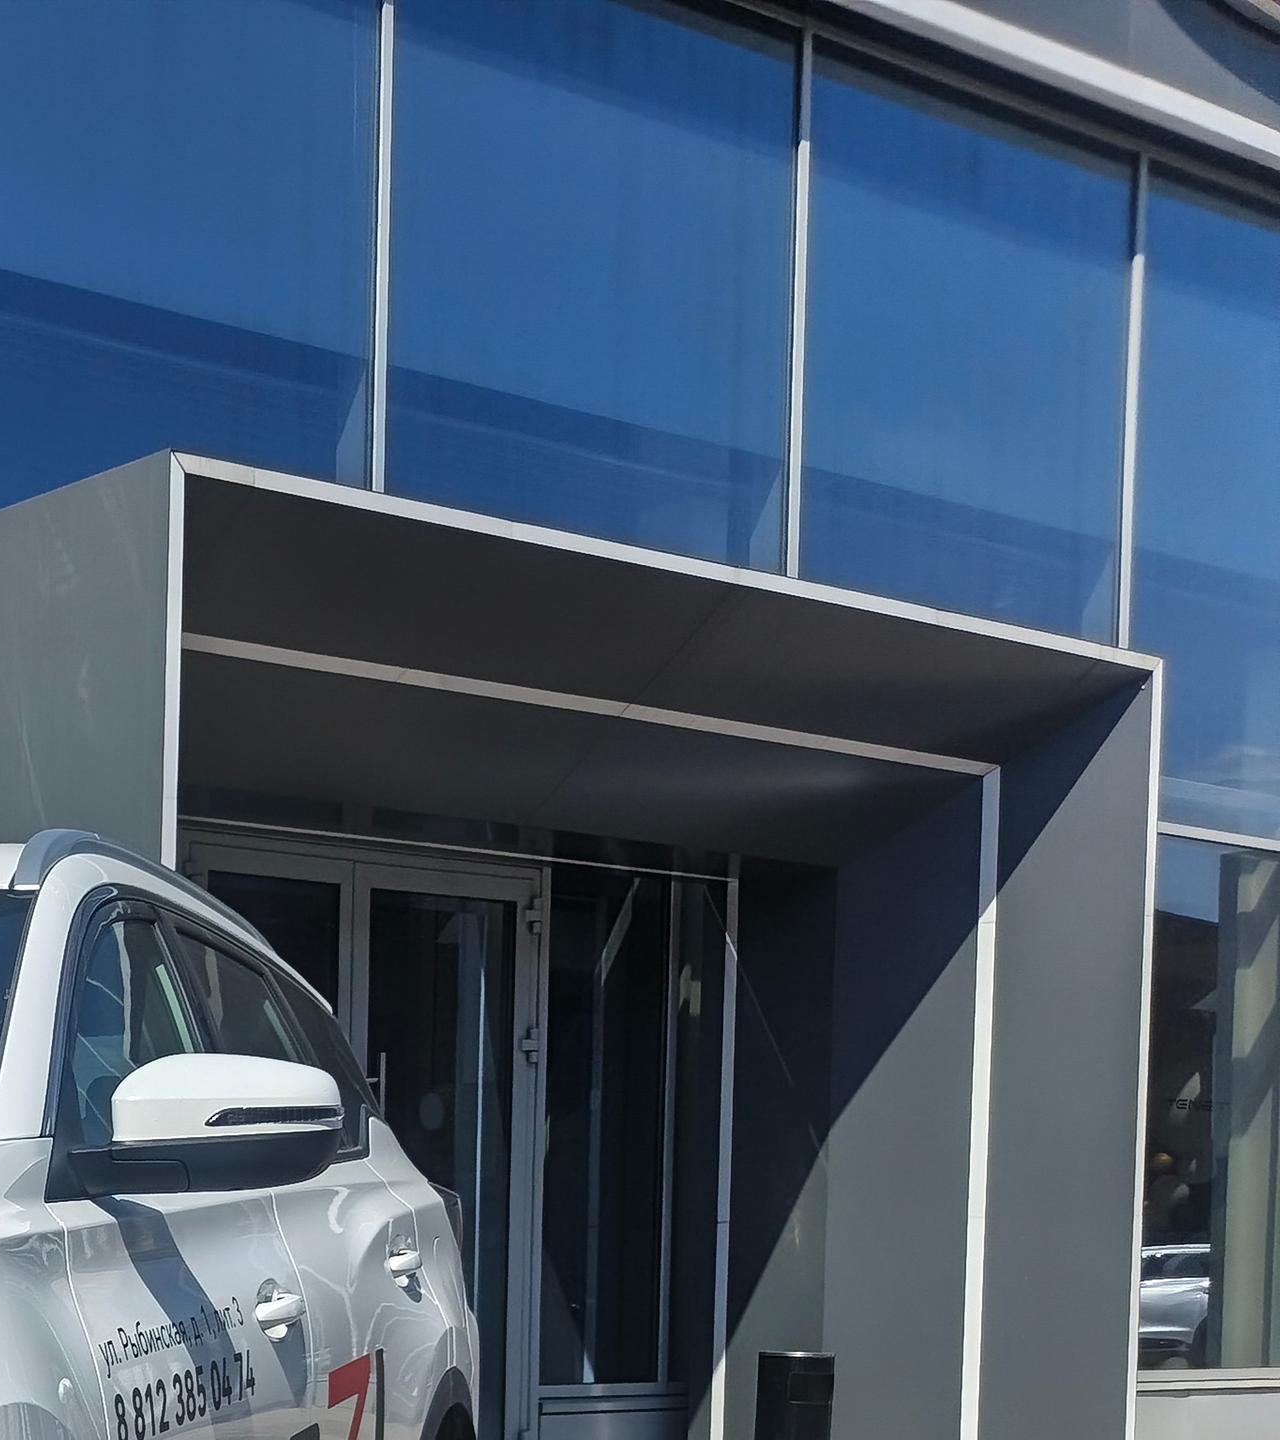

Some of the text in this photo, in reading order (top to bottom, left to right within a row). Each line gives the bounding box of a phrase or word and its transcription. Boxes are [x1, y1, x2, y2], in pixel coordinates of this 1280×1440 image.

[98, 1340, 123, 1379] ул.
[117, 1320, 192, 1362] Рыбинская,
[172, 1365, 207, 1426] 385
[210, 1356, 233, 1411] 04
[233, 1349, 256, 1401] 74
